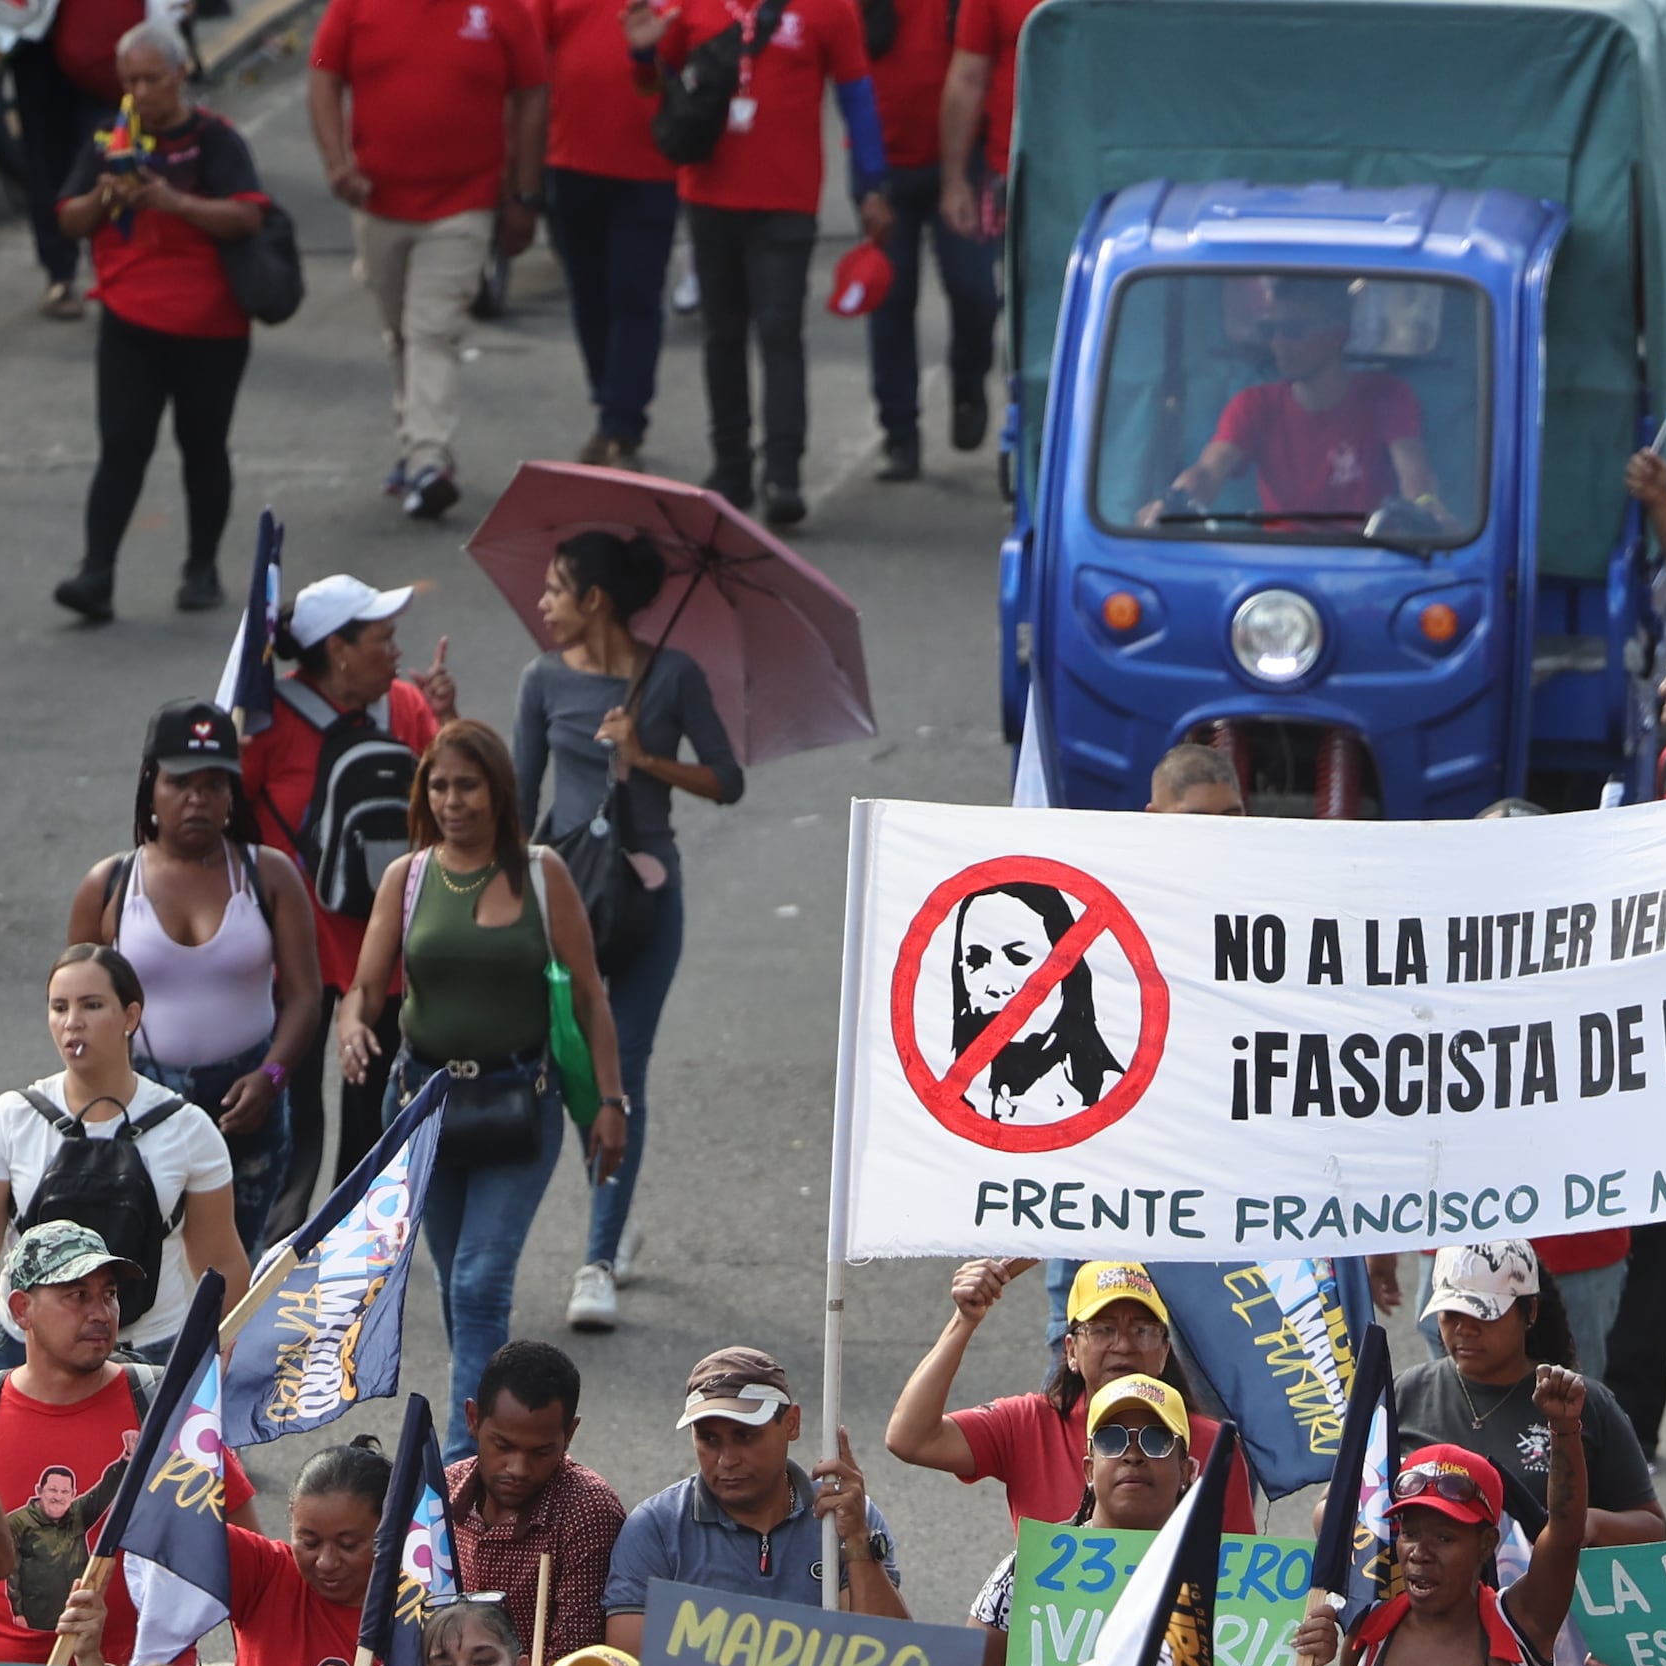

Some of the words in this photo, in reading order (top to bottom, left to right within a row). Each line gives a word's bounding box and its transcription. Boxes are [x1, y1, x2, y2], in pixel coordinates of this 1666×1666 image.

[1214, 914, 1285, 983] NO
[1307, 917, 1343, 986] A
[1366, 918, 1428, 986] LA
[1446, 904, 1596, 984] HITLER
[1230, 1019, 1559, 1121] ¡FASCISTA
[1579, 1004, 1646, 1099] DE
[974, 1178, 1206, 1239] FRENTE
[1235, 1185, 1539, 1244] FRANCISCO
[1564, 1169, 1627, 1220] DE
[1223, 1266, 1276, 1328] EL
[1575, 1558, 1651, 1616] LA
